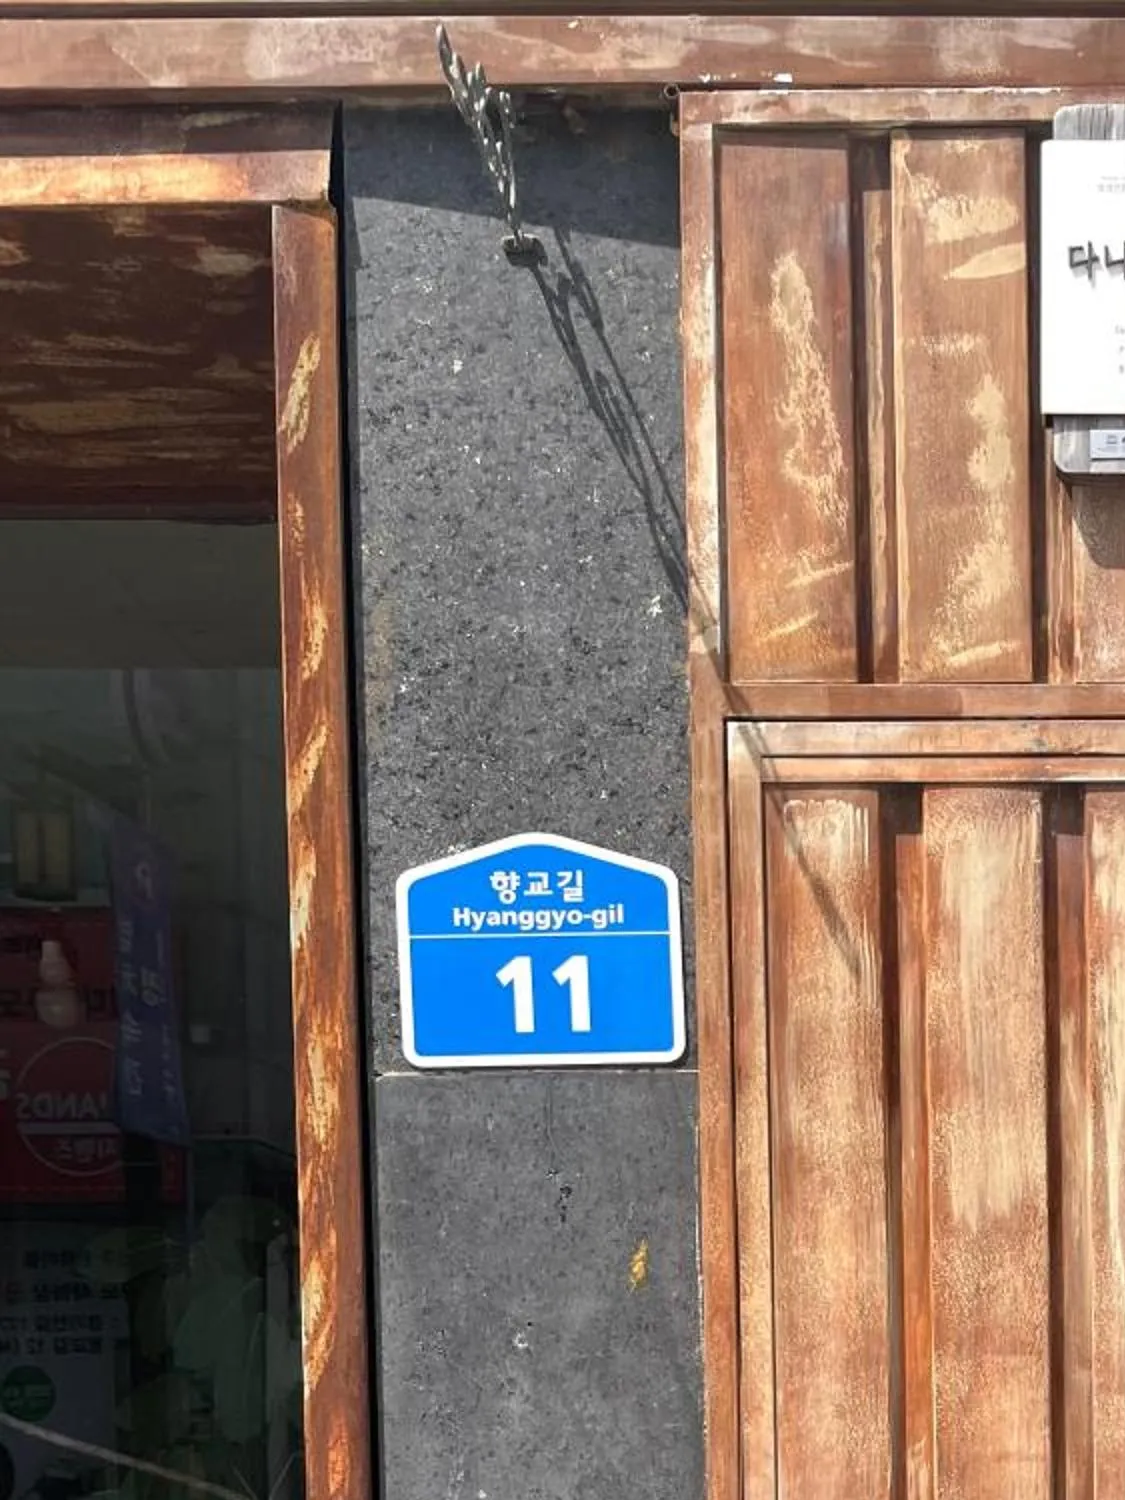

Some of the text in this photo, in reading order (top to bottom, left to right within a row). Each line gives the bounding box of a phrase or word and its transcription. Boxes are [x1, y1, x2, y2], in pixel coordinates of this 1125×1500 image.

[489, 869, 585, 904] 향교길
[452, 903, 625, 931] Hyanggyo-gil
[495, 954, 592, 1034] 11
